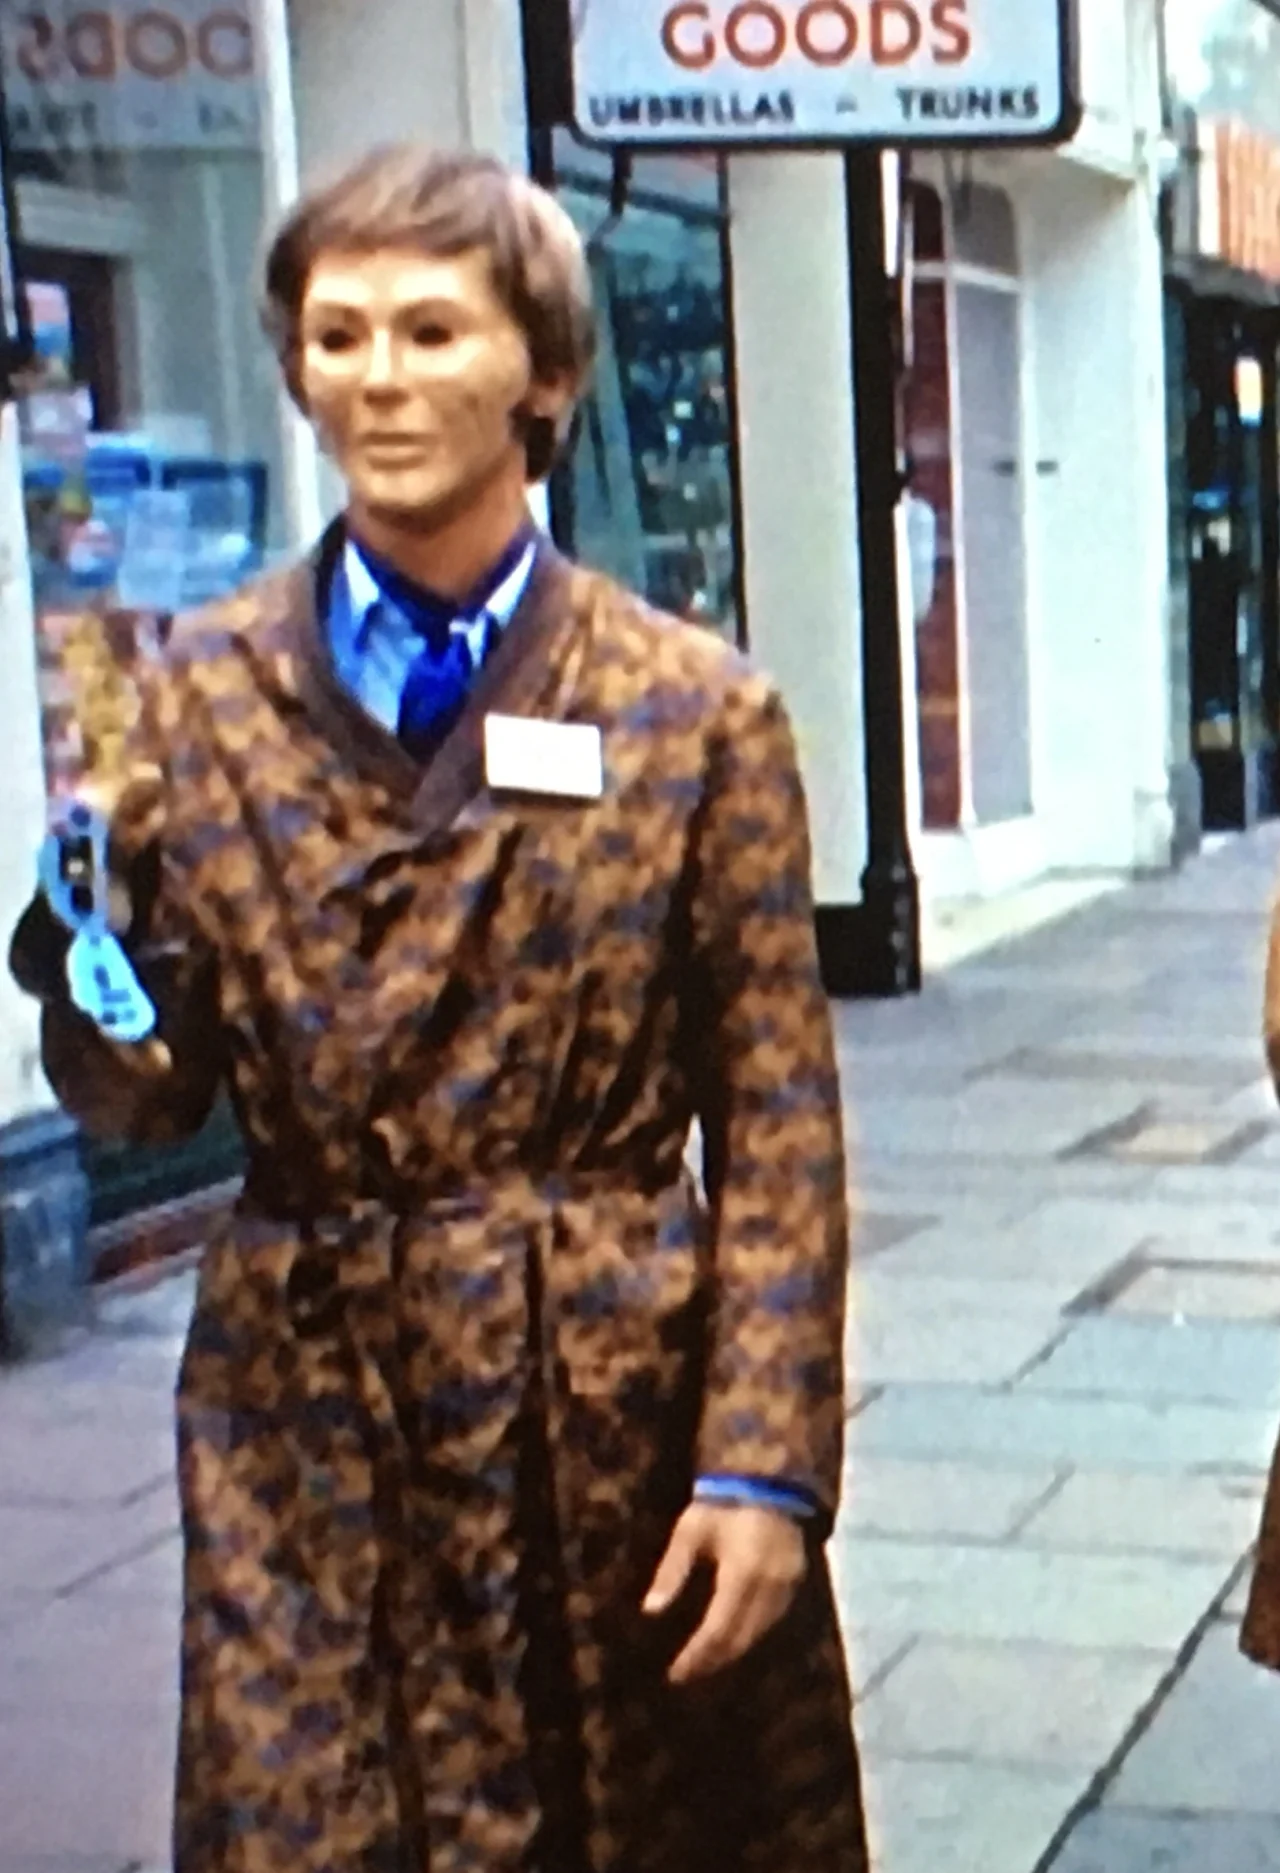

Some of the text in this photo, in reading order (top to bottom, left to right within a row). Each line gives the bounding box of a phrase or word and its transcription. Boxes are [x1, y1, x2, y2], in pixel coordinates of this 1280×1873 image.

[661, 0, 971, 69] GOODS
[589, 84, 1041, 127] UMBRELLAS TRUNKS
